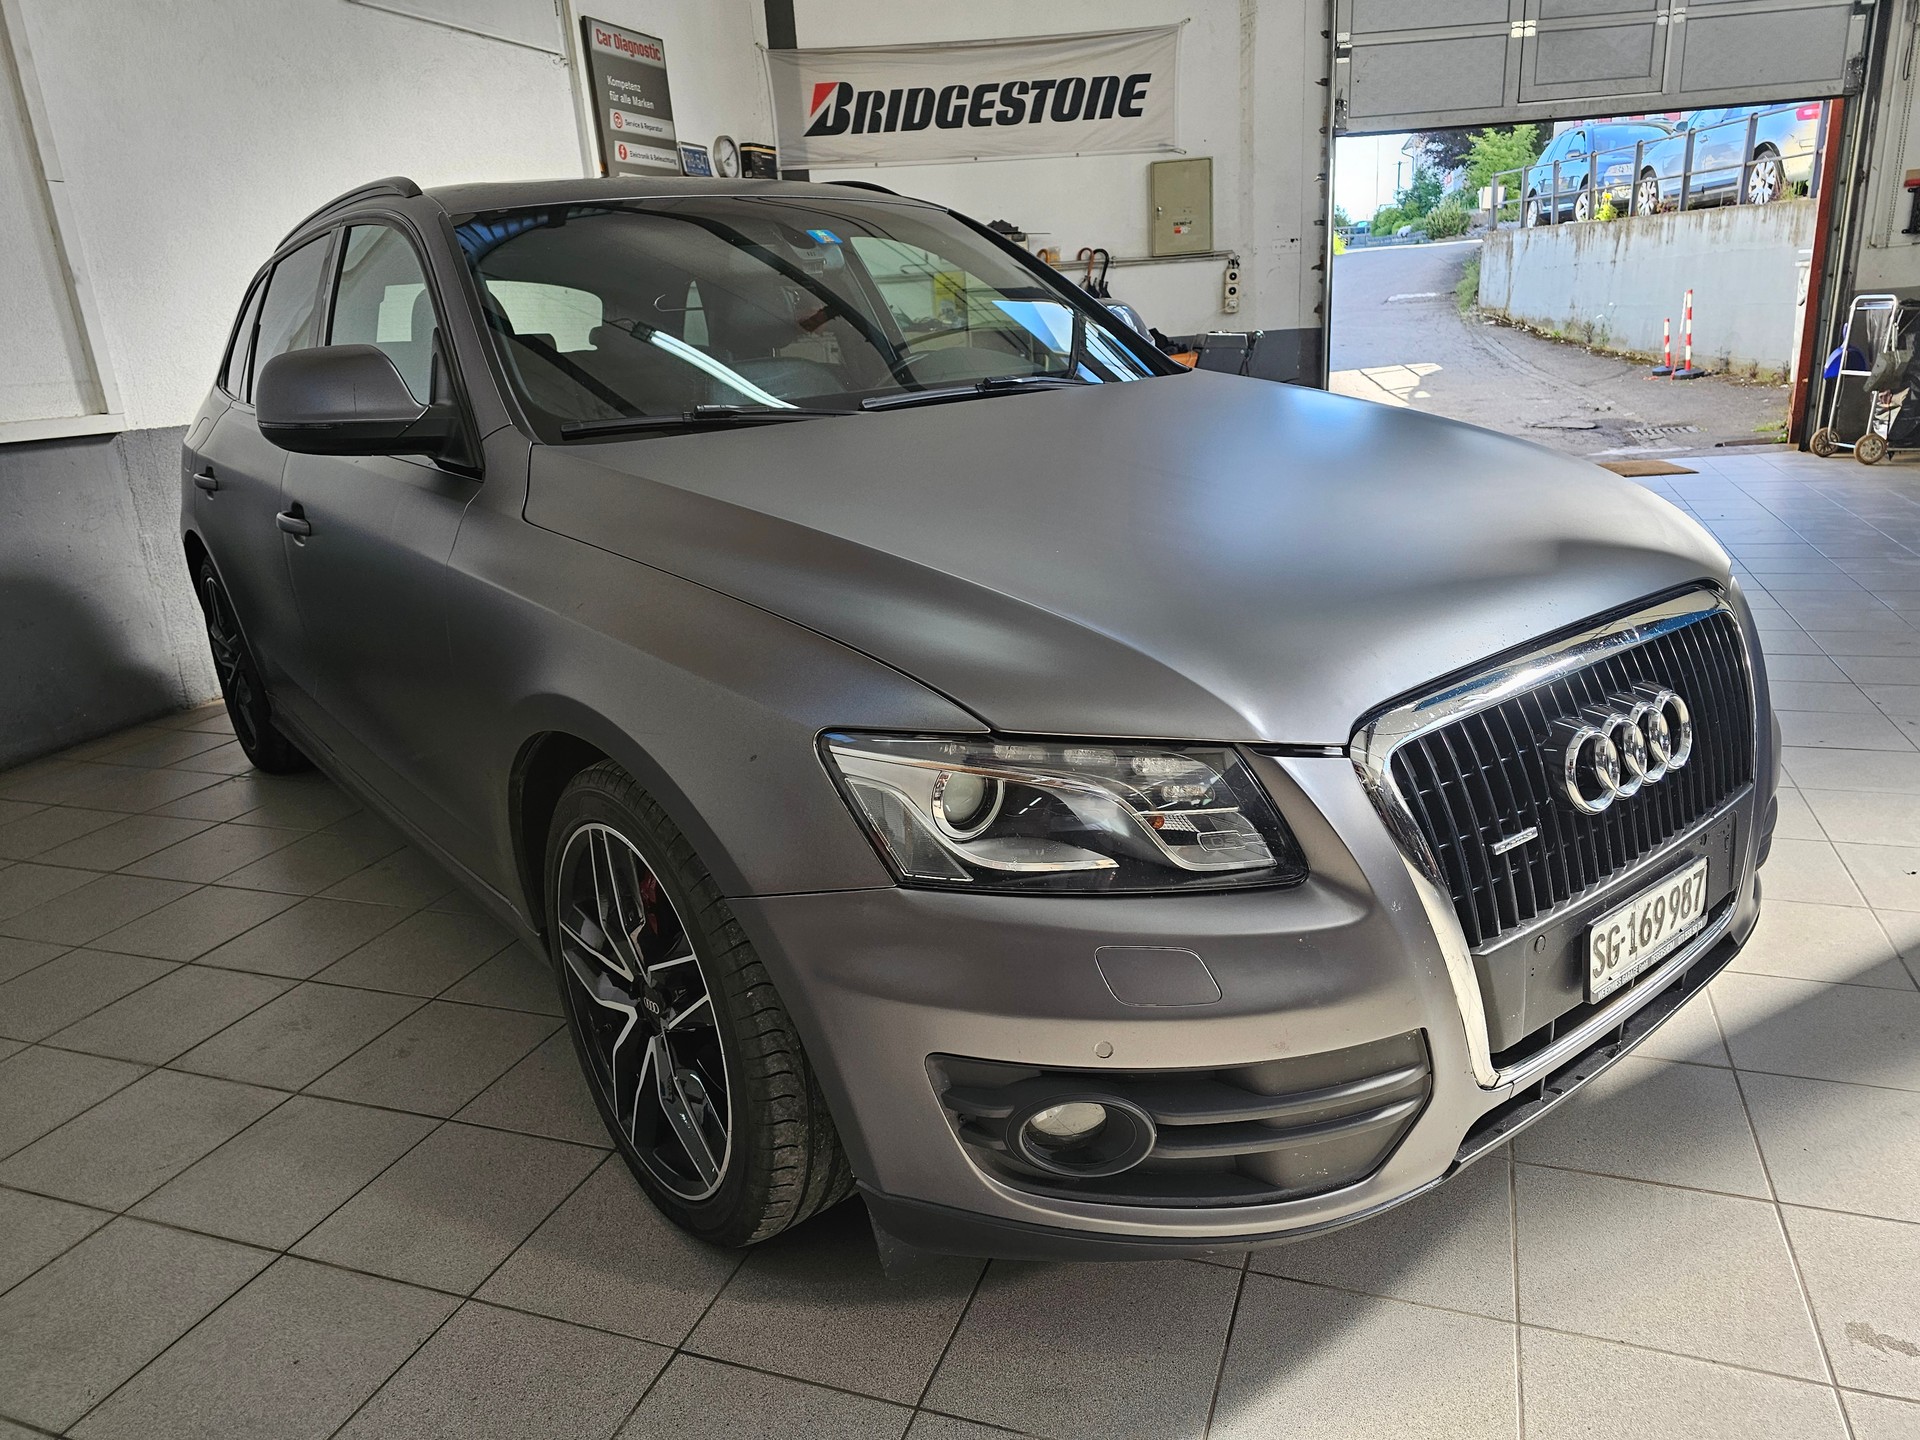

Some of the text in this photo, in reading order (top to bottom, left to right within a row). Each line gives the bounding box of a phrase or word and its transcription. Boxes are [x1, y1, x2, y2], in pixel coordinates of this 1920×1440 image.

[595, 28, 661, 61] Car Diagnostic
[606, 75, 641, 92] Kompetenz
[609, 90, 655, 109] für alle Marken
[803, 73, 1152, 137] BRIDGESTONE
[624, 118, 640, 128] Service
